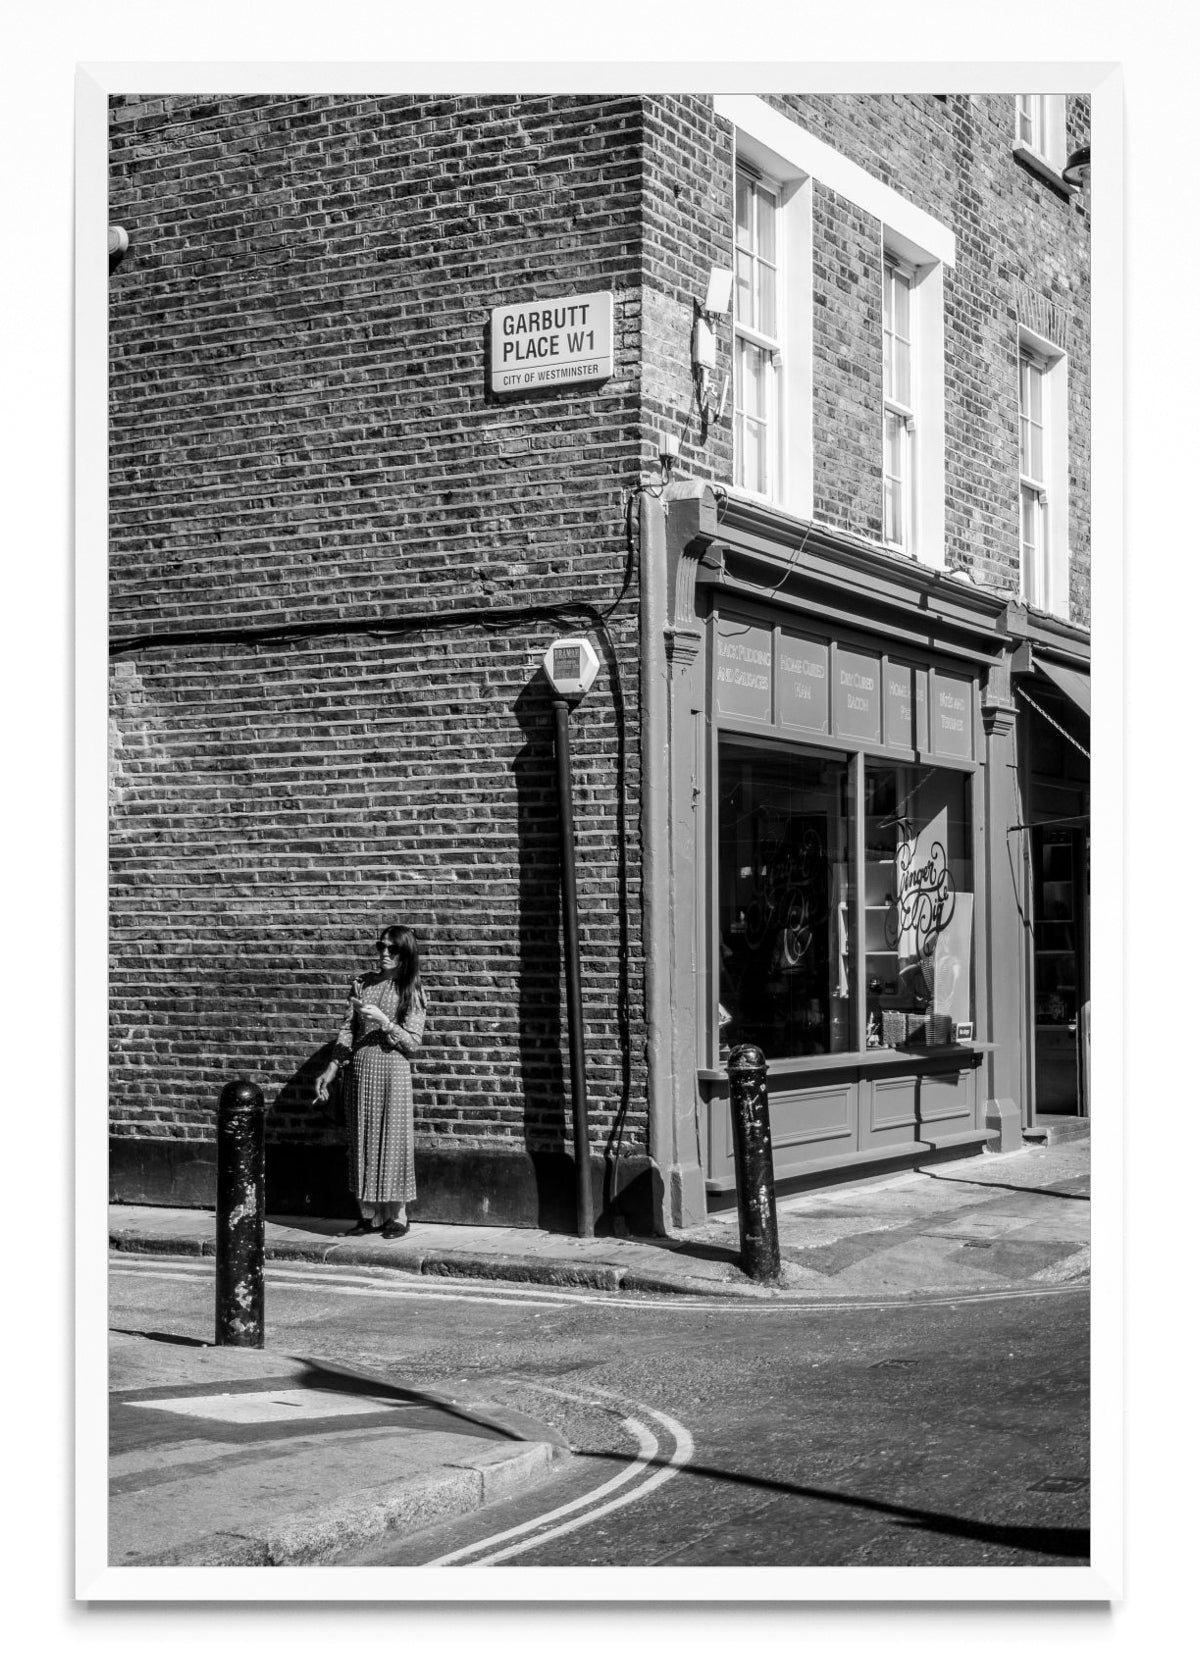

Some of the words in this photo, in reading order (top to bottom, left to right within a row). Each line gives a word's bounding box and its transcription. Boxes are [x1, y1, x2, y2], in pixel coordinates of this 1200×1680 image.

[503, 304, 590, 336] GARBUTT
[503, 335, 560, 362] PLACE
[567, 330, 594, 353] W1
[503, 374, 522, 386] CITY
[524, 372, 535, 383] OF
[538, 364, 599, 381] WESTMINSTER
[738, 645, 771, 667] PUDDING
[717, 666, 735, 683] AND
[735, 668, 769, 690] SAUSAGES
[853, 673, 874, 691] CURED
[847, 694, 869, 712] BACON
